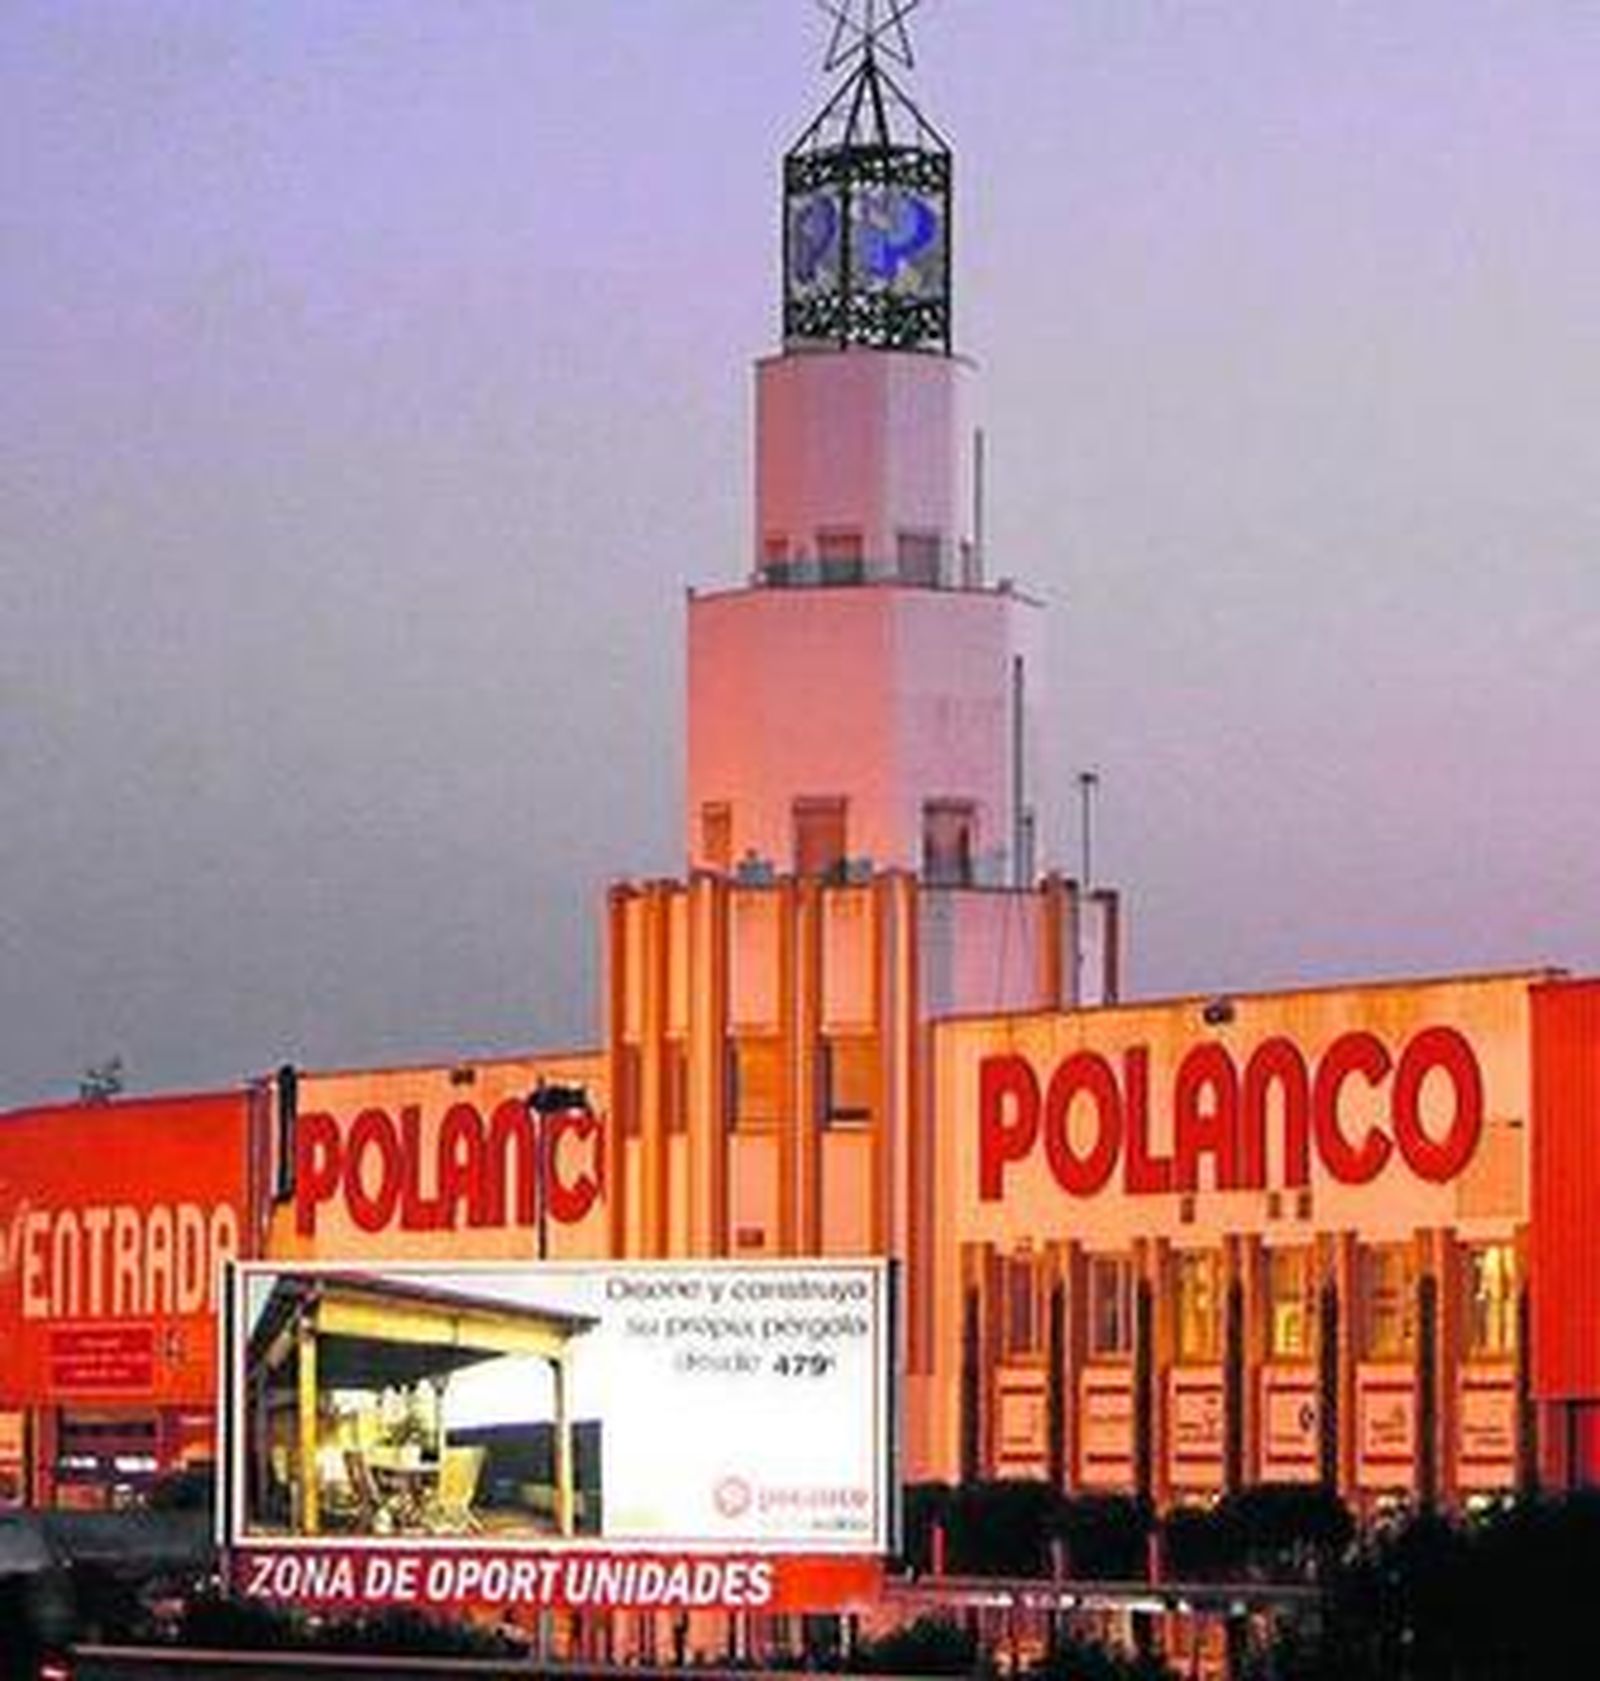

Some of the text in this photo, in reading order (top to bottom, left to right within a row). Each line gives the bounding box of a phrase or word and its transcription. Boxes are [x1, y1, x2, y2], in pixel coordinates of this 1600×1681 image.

[856, 196, 937, 280] P
[296, 1099, 606, 1236] POLANC
[978, 1026, 1483, 1201] POLANCO
[23, 1204, 237, 1318] ENTRADA
[248, 1557, 351, 1598] ZONA
[366, 1560, 419, 1597] DE
